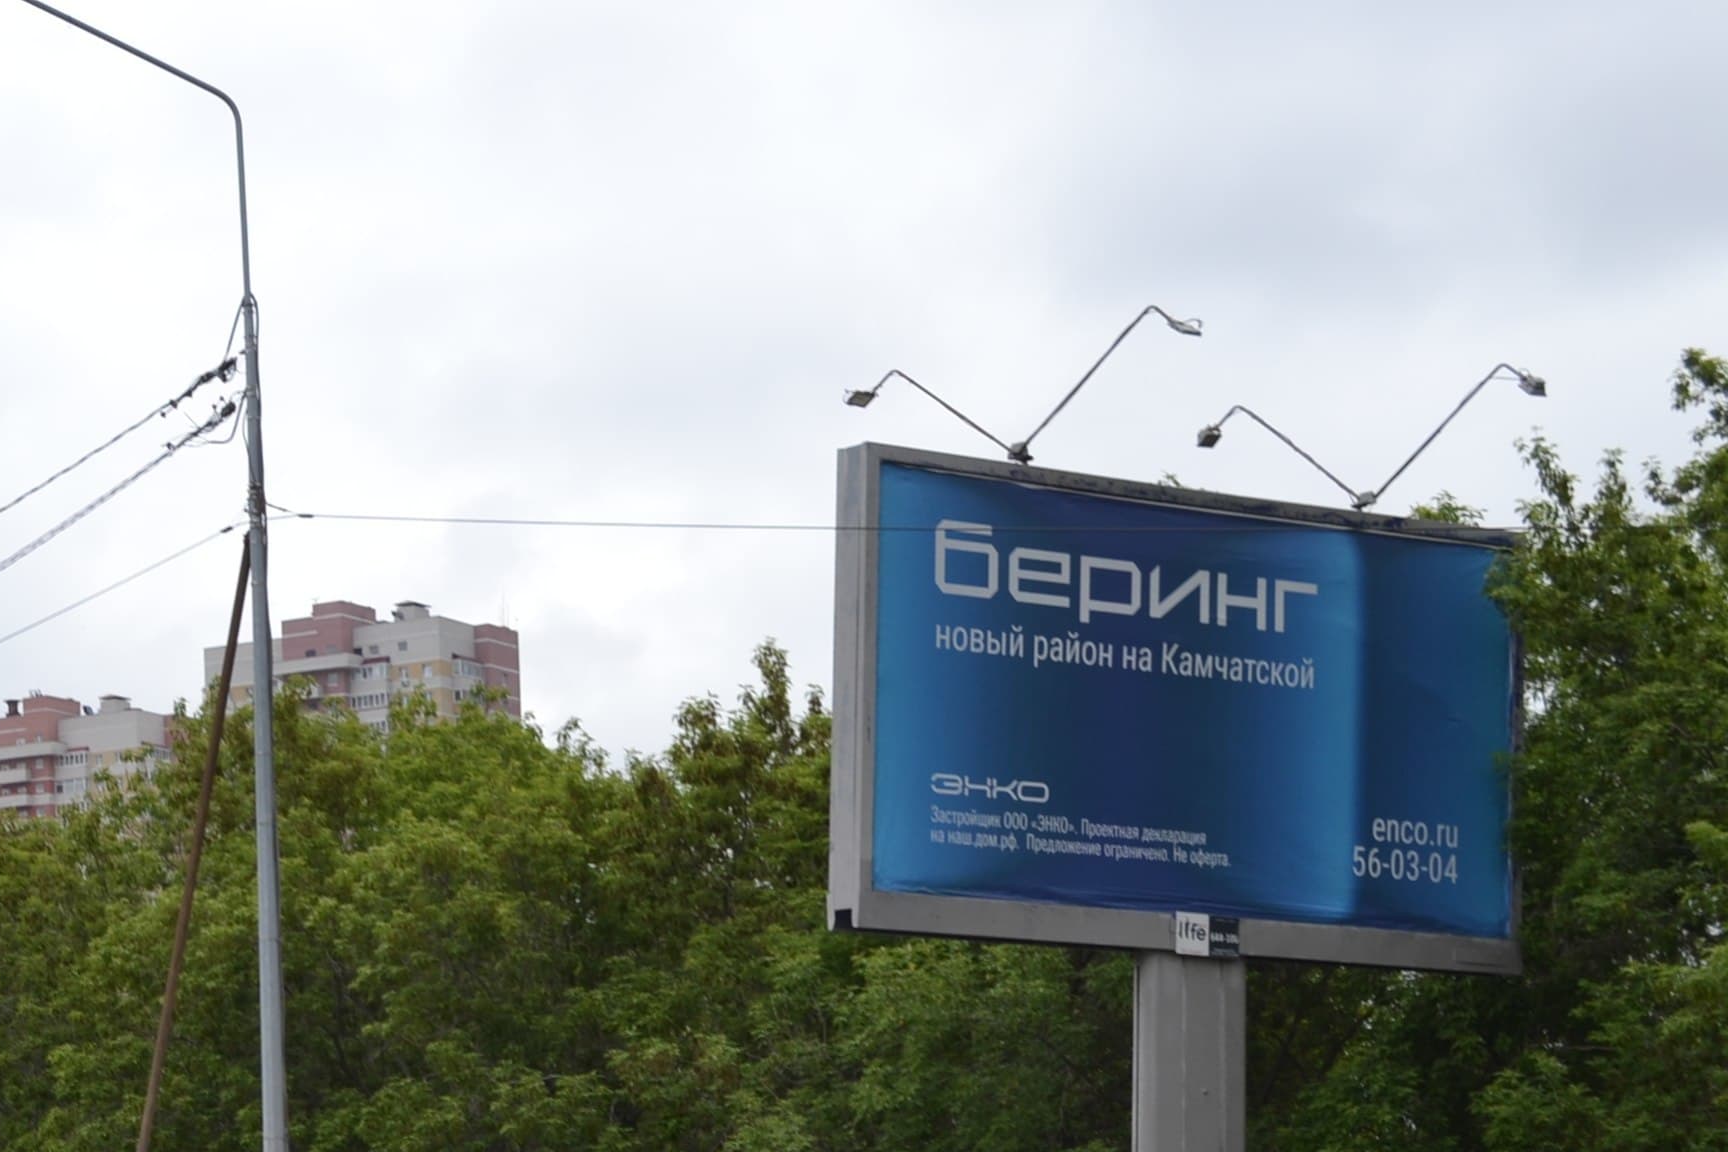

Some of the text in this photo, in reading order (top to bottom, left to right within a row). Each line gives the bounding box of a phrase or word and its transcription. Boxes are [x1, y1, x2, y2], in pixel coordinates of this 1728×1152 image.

[934, 623, 1315, 689] новый район на Камчатской
[930, 804, 1002, 830] Застройщик
[1003, 811, 1028, 831] ООО
[1080, 817, 1139, 840] Проектная
[1141, 827, 1207, 847] декларация
[930, 830, 945, 844] на
[1026, 833, 1102, 857] Предложение
[1372, 816, 1459, 849] enco.ru
[1352, 844, 1459, 885] 56-03-04
